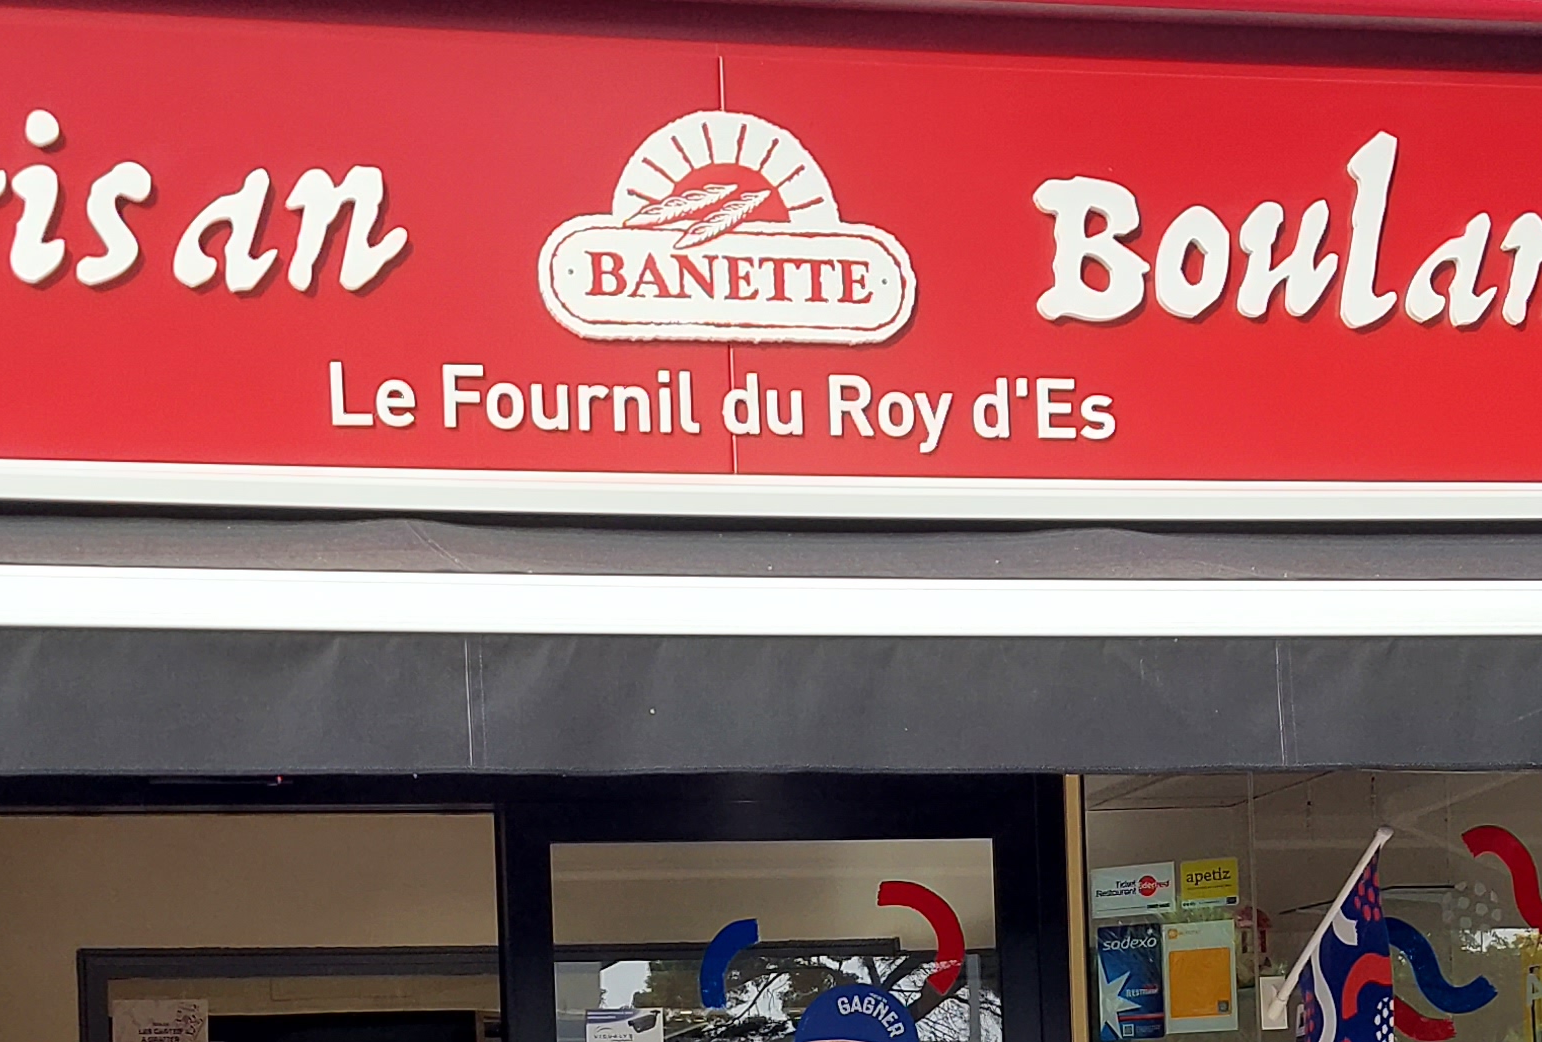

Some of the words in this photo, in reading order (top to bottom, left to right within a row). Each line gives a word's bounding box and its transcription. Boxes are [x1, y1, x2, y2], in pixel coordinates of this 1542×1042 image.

[585, 249, 873, 305] BANETTE
[330, 362, 416, 428] Le
[443, 364, 700, 435] Fournil
[722, 373, 804, 438] du
[841, 375, 953, 454] Roy
[972, 378, 1116, 440] d'Es
[1185, 867, 1232, 886] apetiz
[1102, 935, 1157, 951] sodexo
[837, 994, 905, 1038] GAGNER
